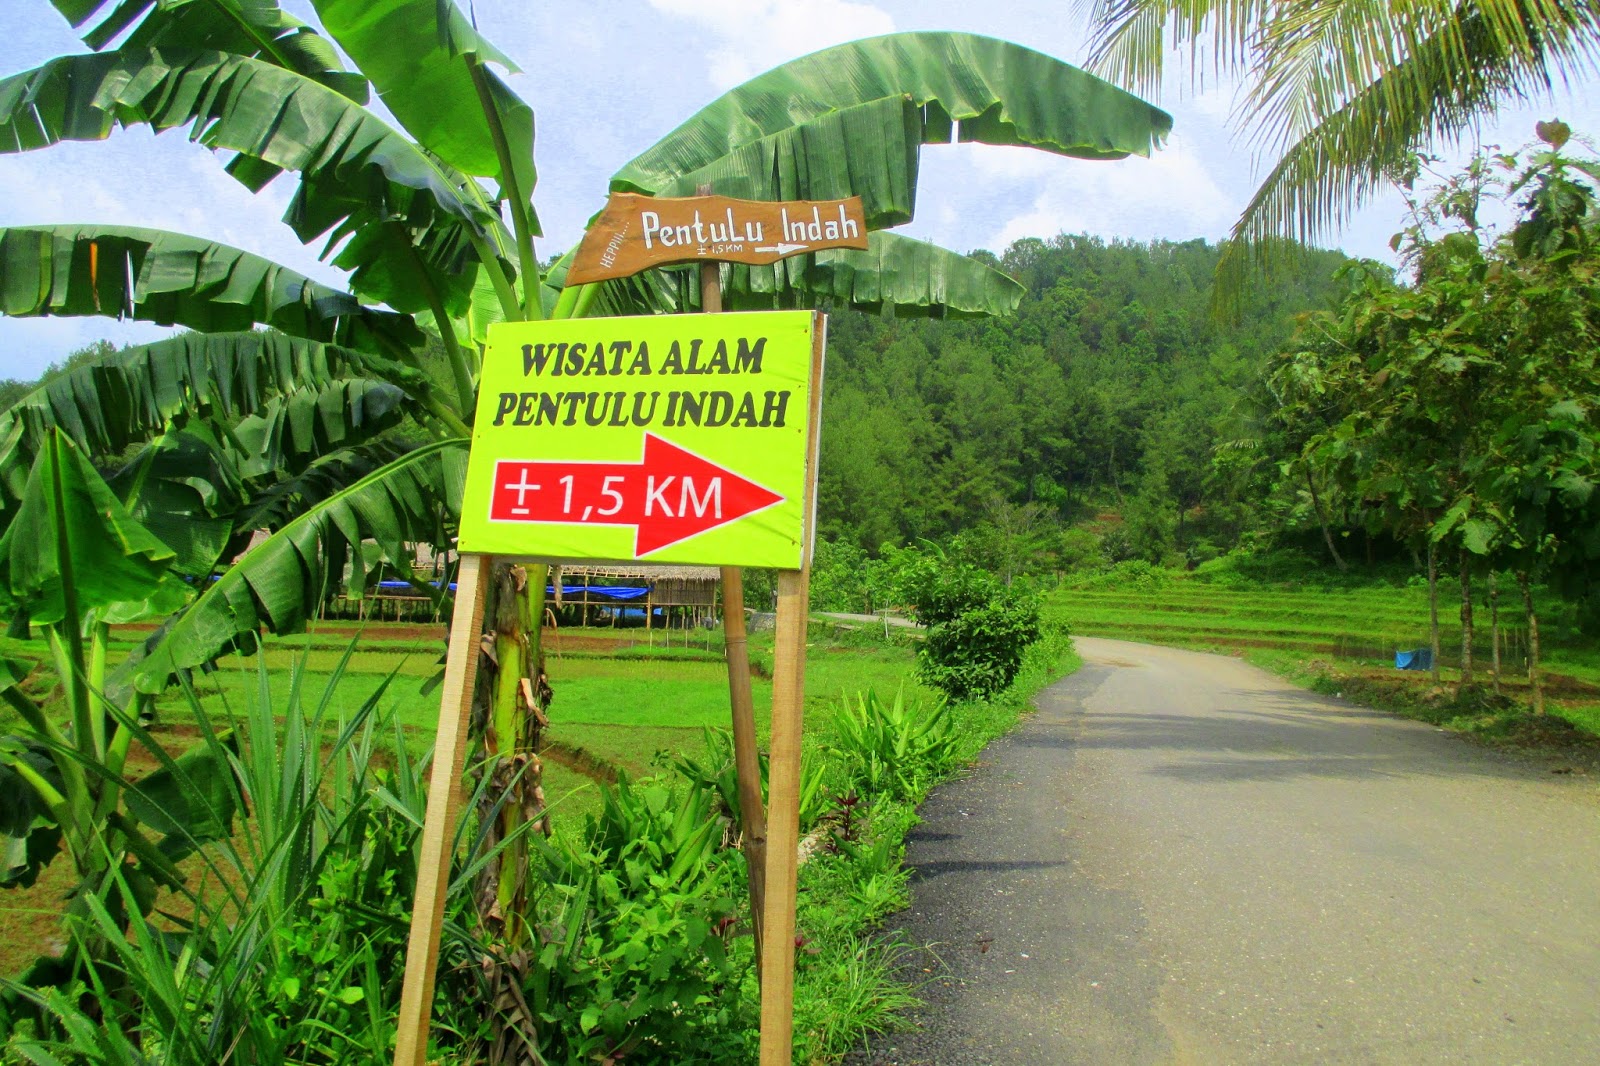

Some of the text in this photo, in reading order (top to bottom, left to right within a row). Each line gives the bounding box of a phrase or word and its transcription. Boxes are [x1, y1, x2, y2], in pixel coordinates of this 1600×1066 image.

[781, 204, 859, 242] Indah
[521, 337, 768, 376] WISATA ALAM
[493, 390, 791, 428] PENTULU INDAH
[558, 474, 625, 521] 1,5
[644, 475, 722, 519] KM
